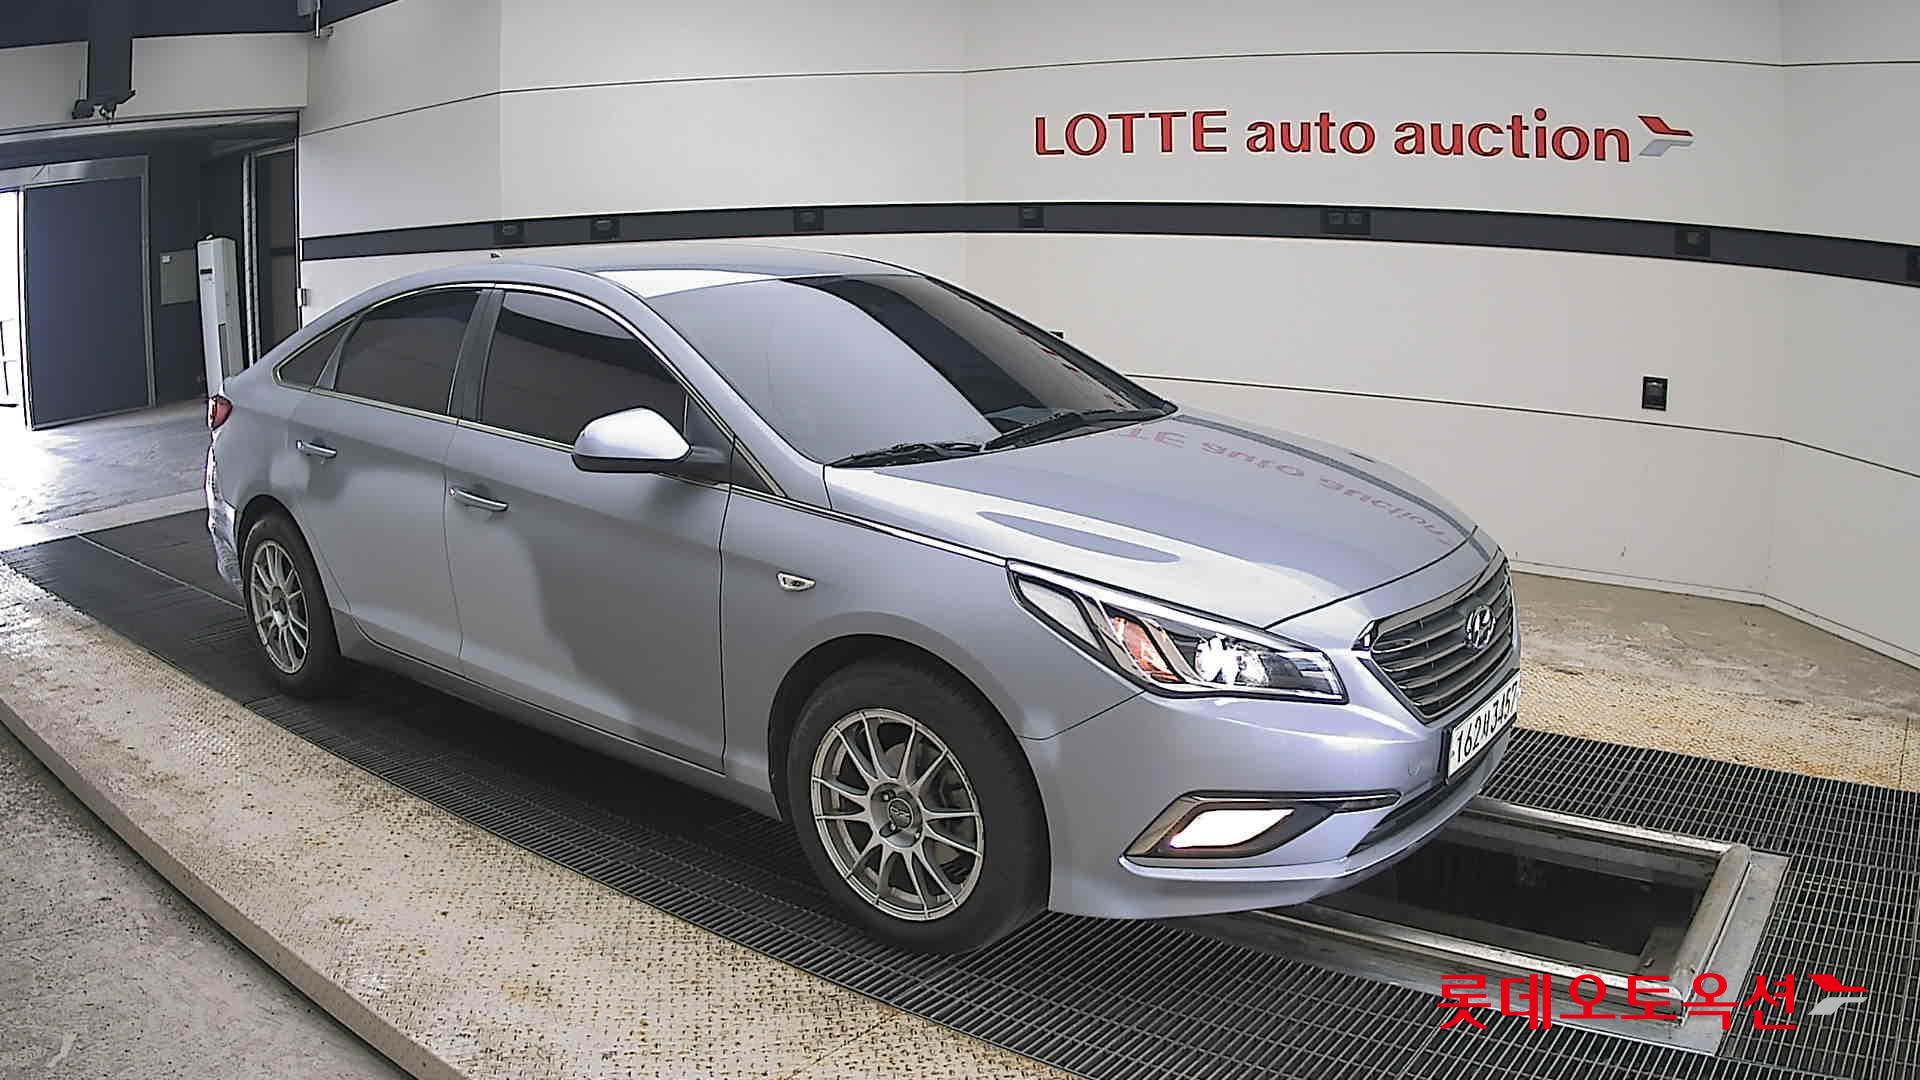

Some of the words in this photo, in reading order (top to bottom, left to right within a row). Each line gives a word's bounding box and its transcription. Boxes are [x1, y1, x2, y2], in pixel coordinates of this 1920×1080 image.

[1035, 110, 1228, 155] LOTTE
[1246, 111, 1376, 154] auto
[1394, 107, 1631, 162] auction
